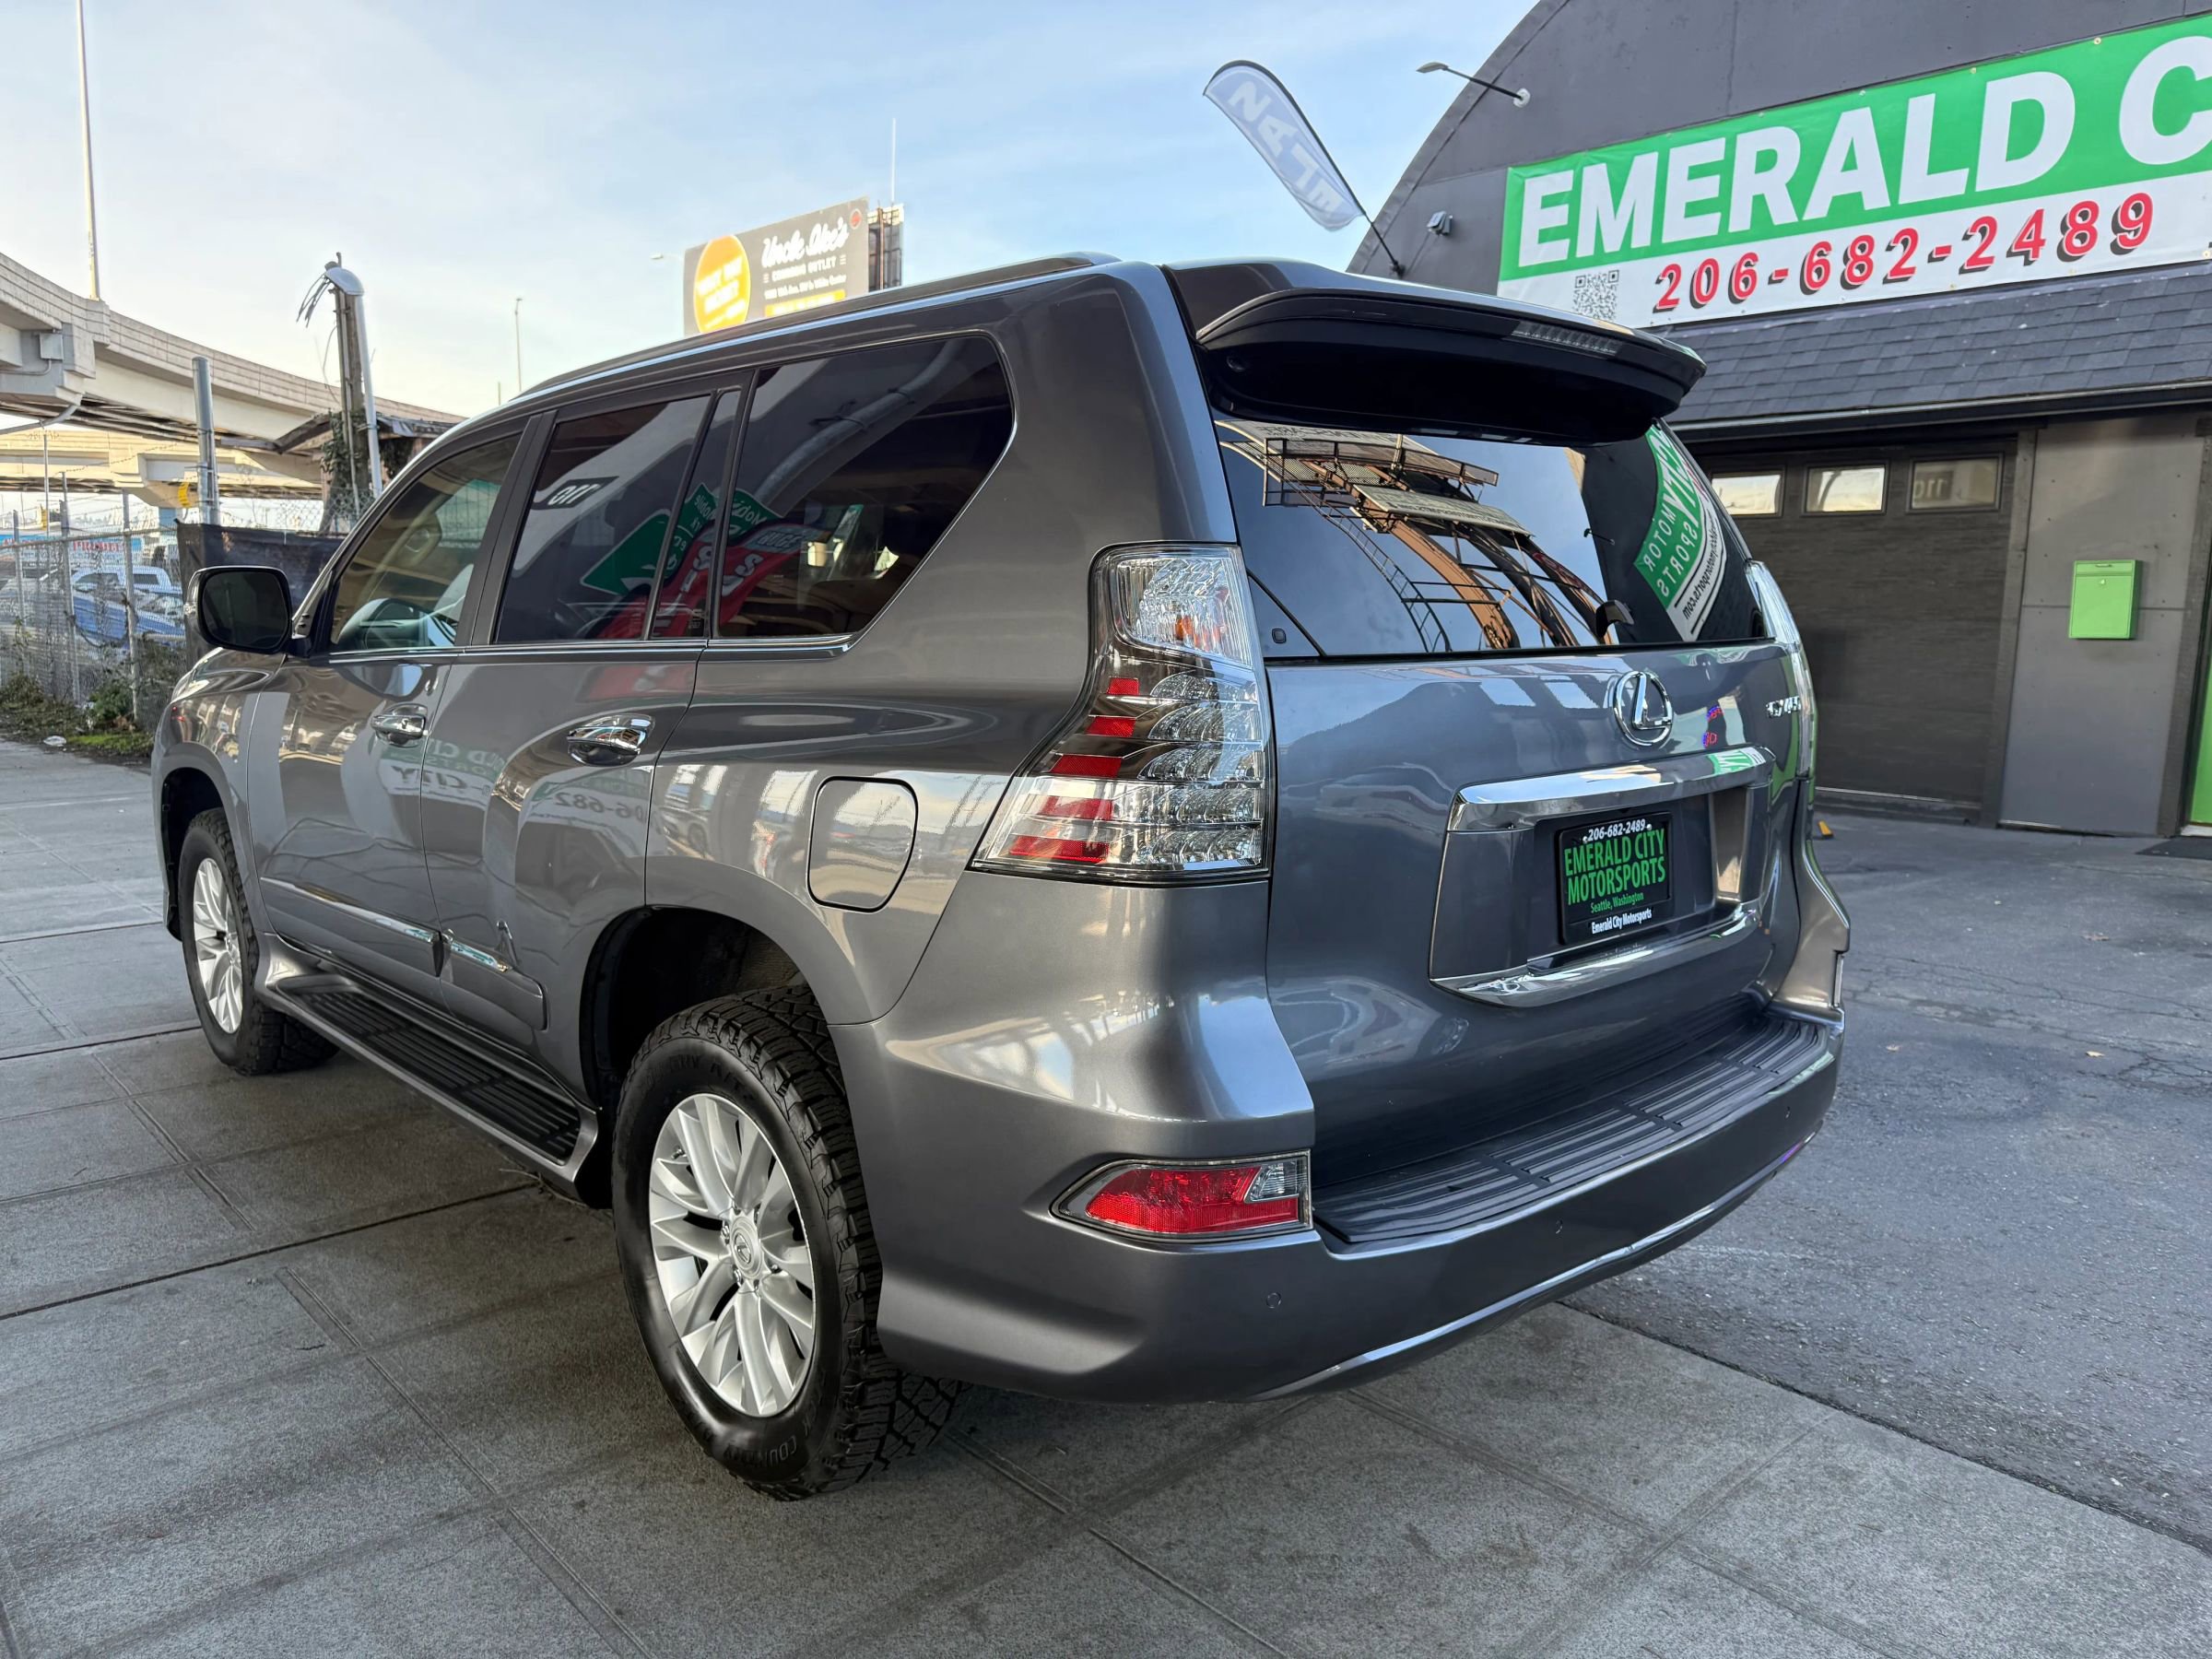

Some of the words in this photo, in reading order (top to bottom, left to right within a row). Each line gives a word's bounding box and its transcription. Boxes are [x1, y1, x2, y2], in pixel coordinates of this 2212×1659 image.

[1518, 71, 2076, 267] EMERALD
[1653, 191, 2155, 312] 206-682-2489
[1563, 835, 1632, 877] EMERALD
[1634, 828, 1665, 859] CITY
[1588, 818, 1646, 841] 206-682-2489
[1567, 855, 1666, 906] MOTORSPORTS
[1591, 899, 1613, 914] Seattle,
[1612, 891, 1644, 908] Washington
[1591, 916, 1613, 935] Emerald
[1612, 914, 1623, 930] City
[1622, 907, 1653, 925] Motorsports
